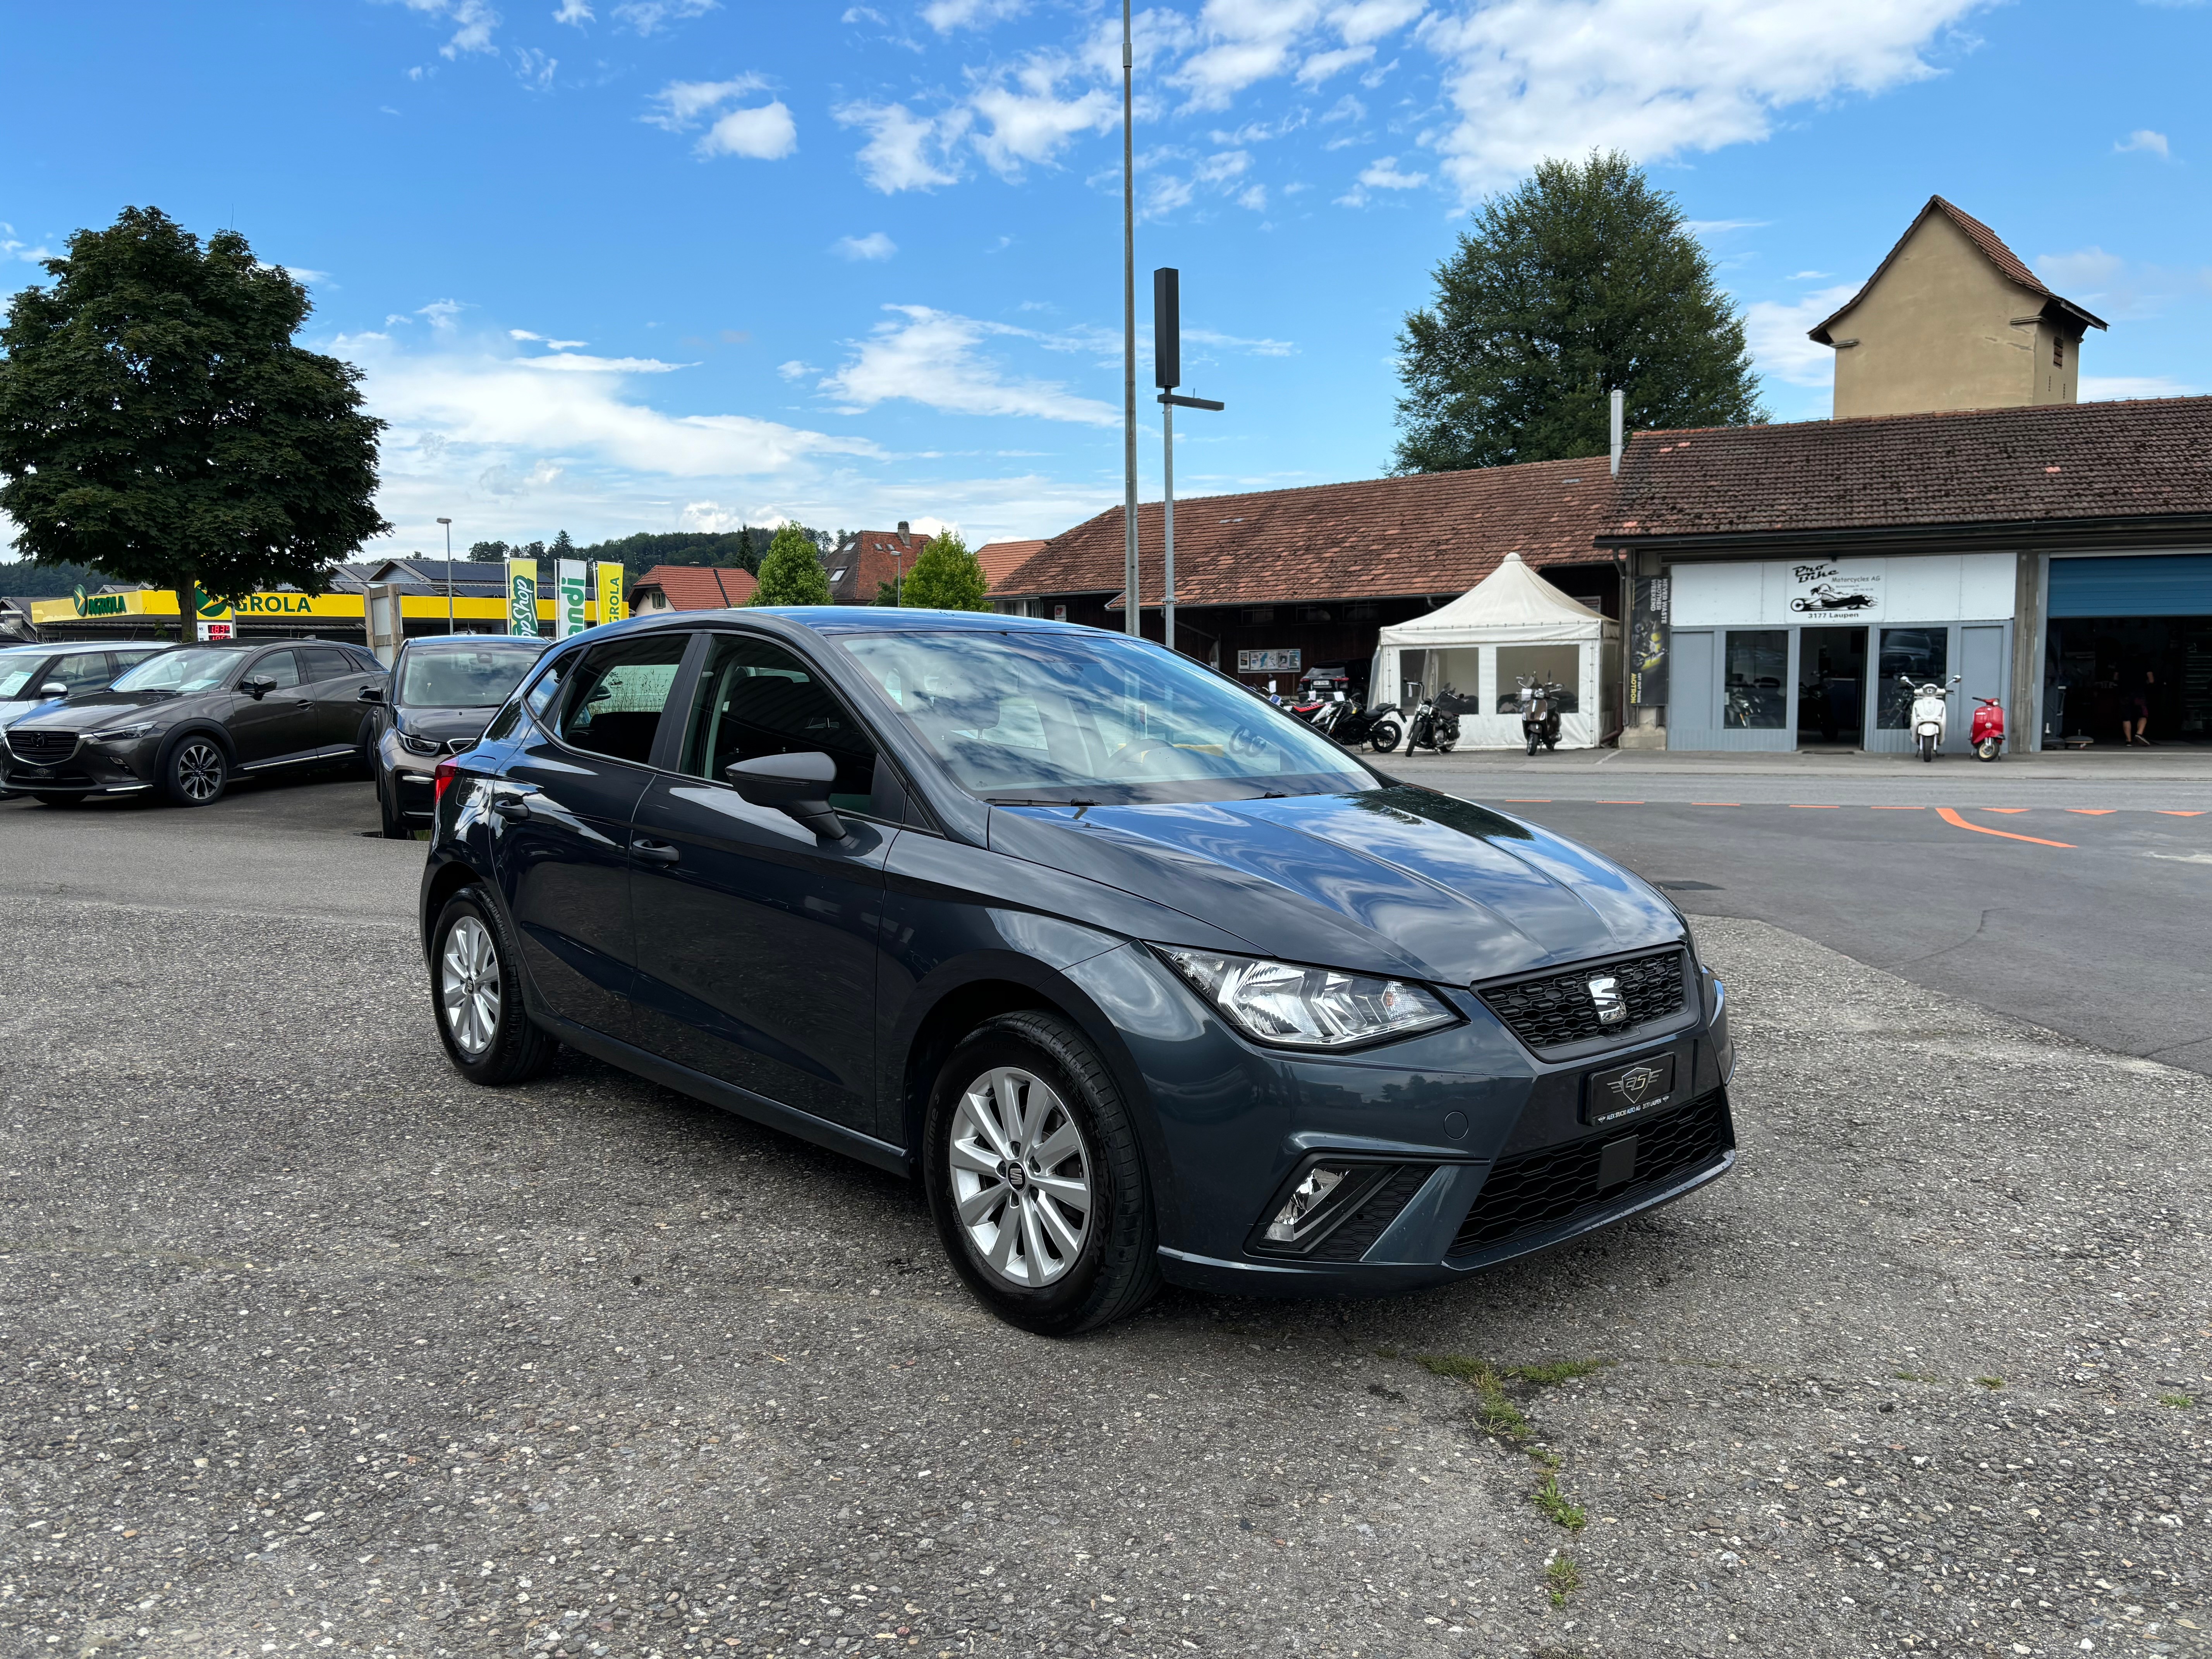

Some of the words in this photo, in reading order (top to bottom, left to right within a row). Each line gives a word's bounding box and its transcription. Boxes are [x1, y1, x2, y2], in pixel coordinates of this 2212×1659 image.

[88, 596, 127, 616] AGROLA
[235, 596, 312, 613] GROLA
[562, 577, 585, 636] andi
[609, 577, 620, 623] GROLA
